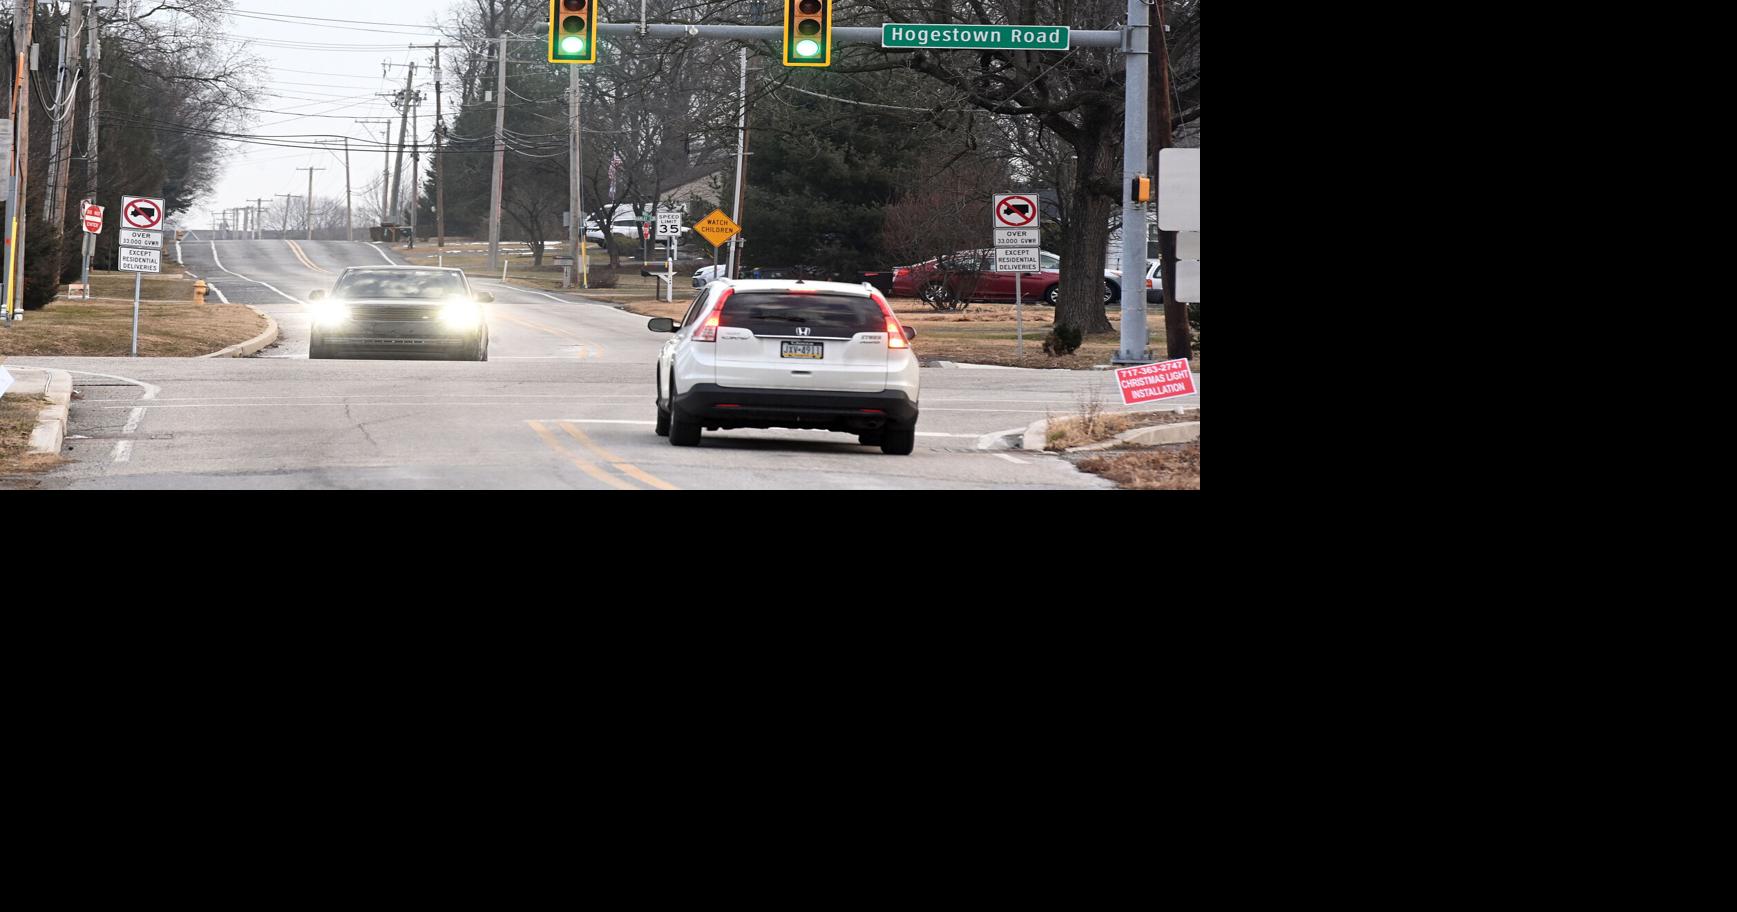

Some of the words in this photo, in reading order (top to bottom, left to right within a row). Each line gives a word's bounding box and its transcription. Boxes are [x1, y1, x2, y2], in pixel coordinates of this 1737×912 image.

[891, 27, 1001, 45] Hogestown
[1011, 28, 1060, 43] Road
[659, 224, 679, 234] 35
[122, 256, 158, 264] RESIDENTIAL
[122, 263, 157, 271] DELIVERIES
[1120, 361, 1183, 378] 717-363-2747
[1121, 374, 1166, 389] CHRISTMAS
[1166, 369, 1189, 381] LIGHT
[1131, 382, 1185, 399] INSTALLATION
